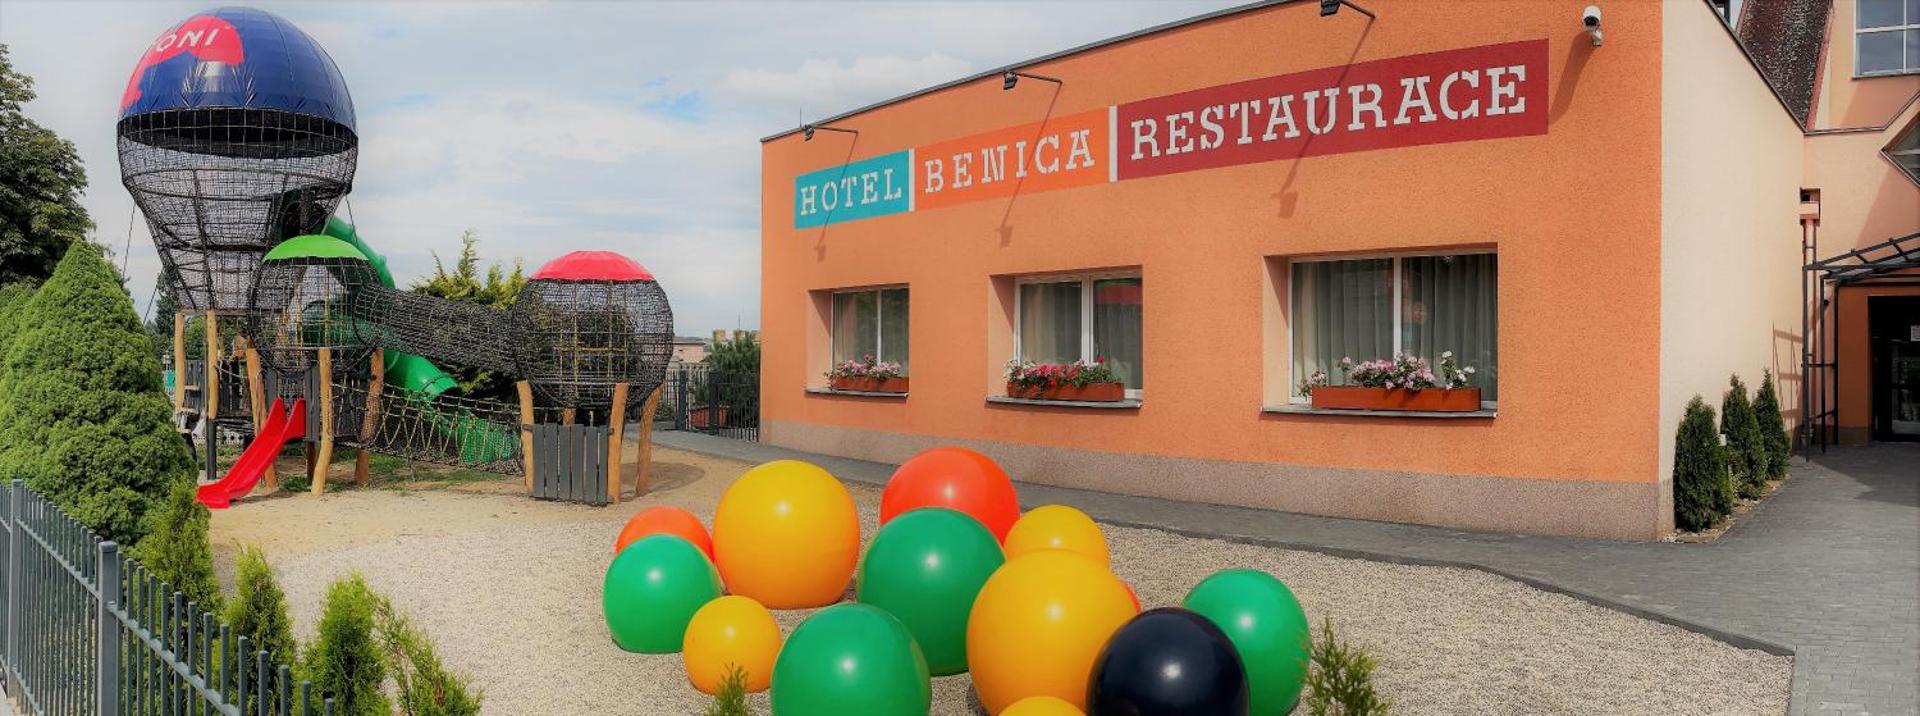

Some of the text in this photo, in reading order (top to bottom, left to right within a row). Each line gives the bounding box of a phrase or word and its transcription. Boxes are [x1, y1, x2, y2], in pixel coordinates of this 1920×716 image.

[152, 28, 219, 52] ONI
[800, 64, 1527, 215] HOTEL BENICA RESTAURACE
